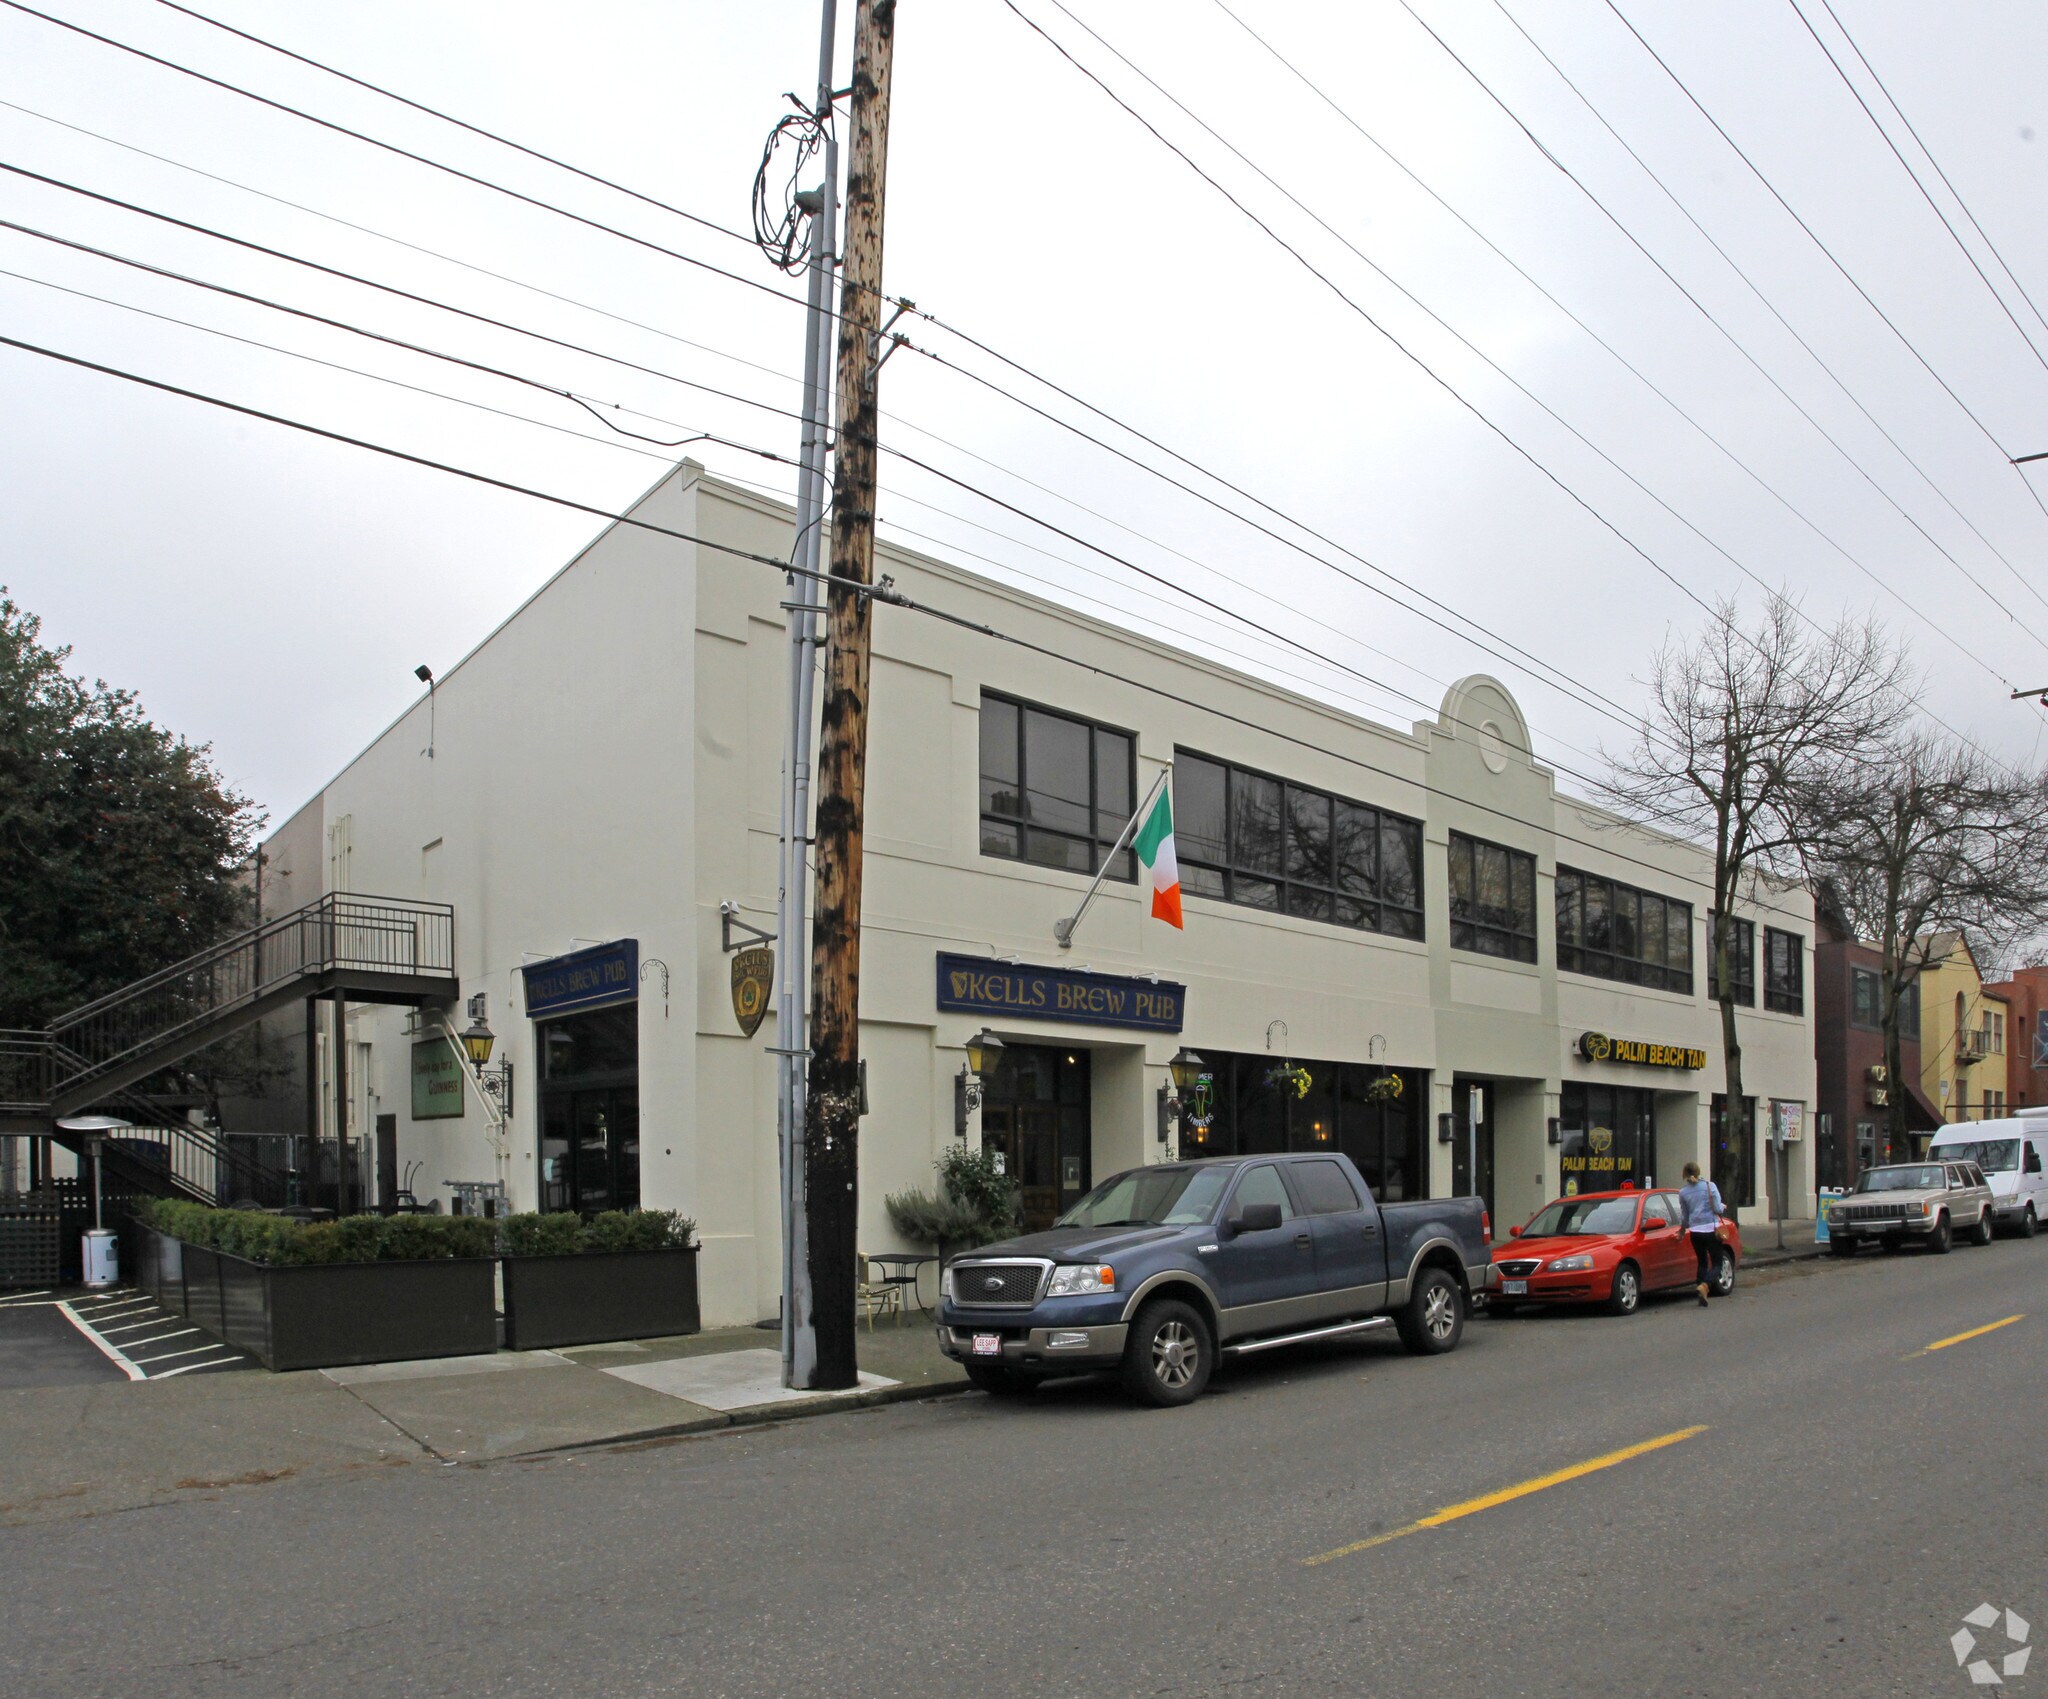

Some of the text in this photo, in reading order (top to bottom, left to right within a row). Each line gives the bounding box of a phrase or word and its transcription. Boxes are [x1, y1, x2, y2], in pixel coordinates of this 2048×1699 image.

[569, 966, 600, 993] BREW
[604, 960, 627, 984] PUB
[969, 972, 1176, 1020] KELLS BREW PUB
[1616, 1040, 1706, 1068] PALM BEACH TAN
[428, 1079, 458, 1095] GUINNESS
[1187, 1112, 1214, 1127] TIMBERS
[1562, 1156, 1632, 1171] PALM BEACH TAN
